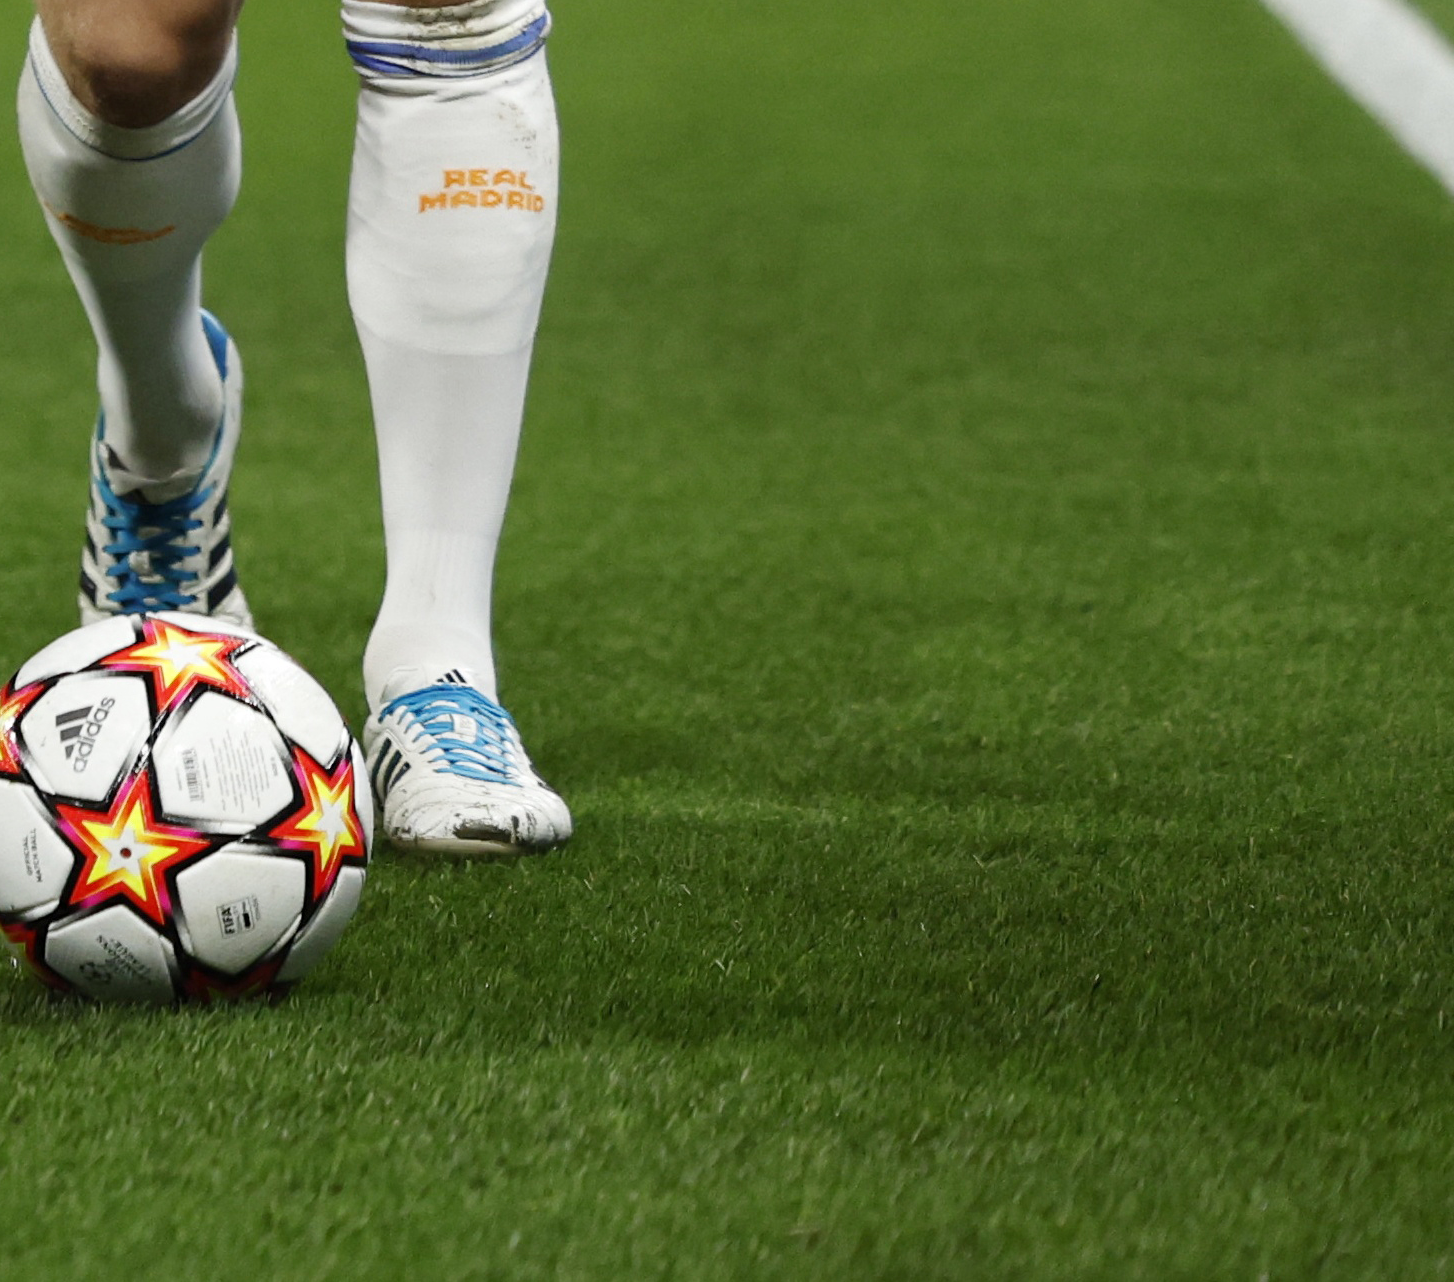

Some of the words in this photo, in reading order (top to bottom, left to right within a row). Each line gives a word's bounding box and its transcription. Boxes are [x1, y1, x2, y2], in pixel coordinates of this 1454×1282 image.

[443, 168, 534, 191] REAL
[418, 190, 545, 214] MADRID
[73, 696, 116, 773] adidas
[221, 906, 236, 935] FIFA
